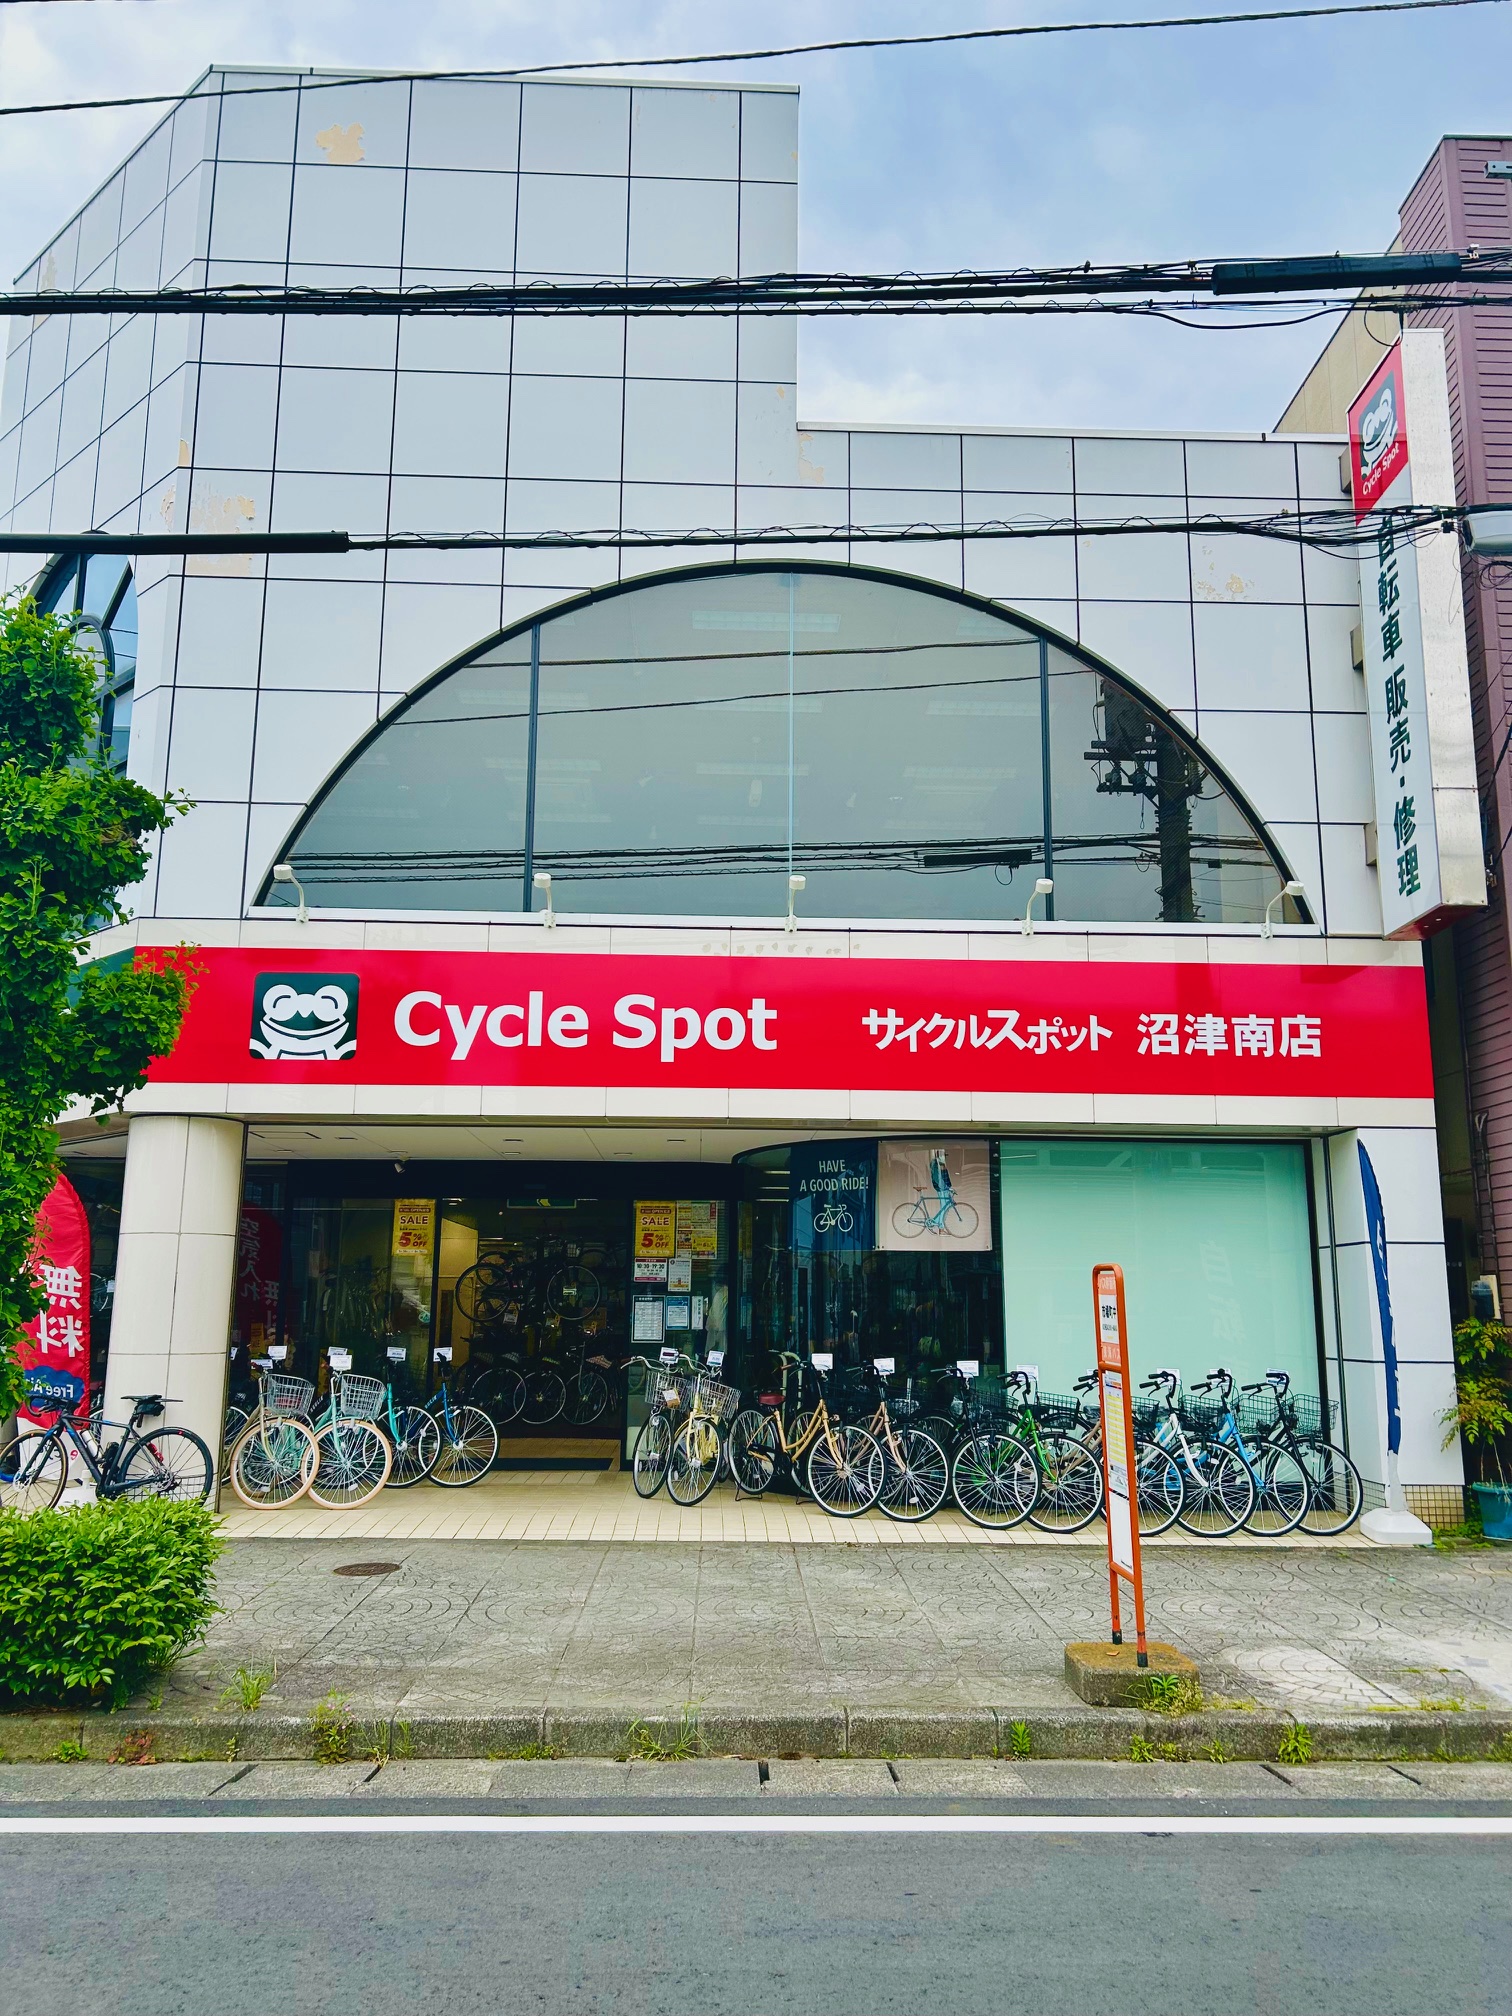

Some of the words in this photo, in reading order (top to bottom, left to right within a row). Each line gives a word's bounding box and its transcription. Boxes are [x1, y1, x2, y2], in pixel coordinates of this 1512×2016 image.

[1362, 466, 1382, 496] Cycle
[1381, 442, 1400, 472] Spot
[393, 990, 589, 1060] Cycle
[612, 993, 778, 1062] Spot
[861, 1008, 1113, 1054] サイクルスポット
[1137, 1013, 1322, 1057] 沼津南店
[818, 1159, 847, 1173] HAVE
[799, 1179, 807, 1192] A
[809, 1177, 839, 1192] GOOD
[841, 1176, 869, 1191] RIDE!
[400, 1215, 428, 1225] SALE
[641, 1216, 670, 1226] SALE
